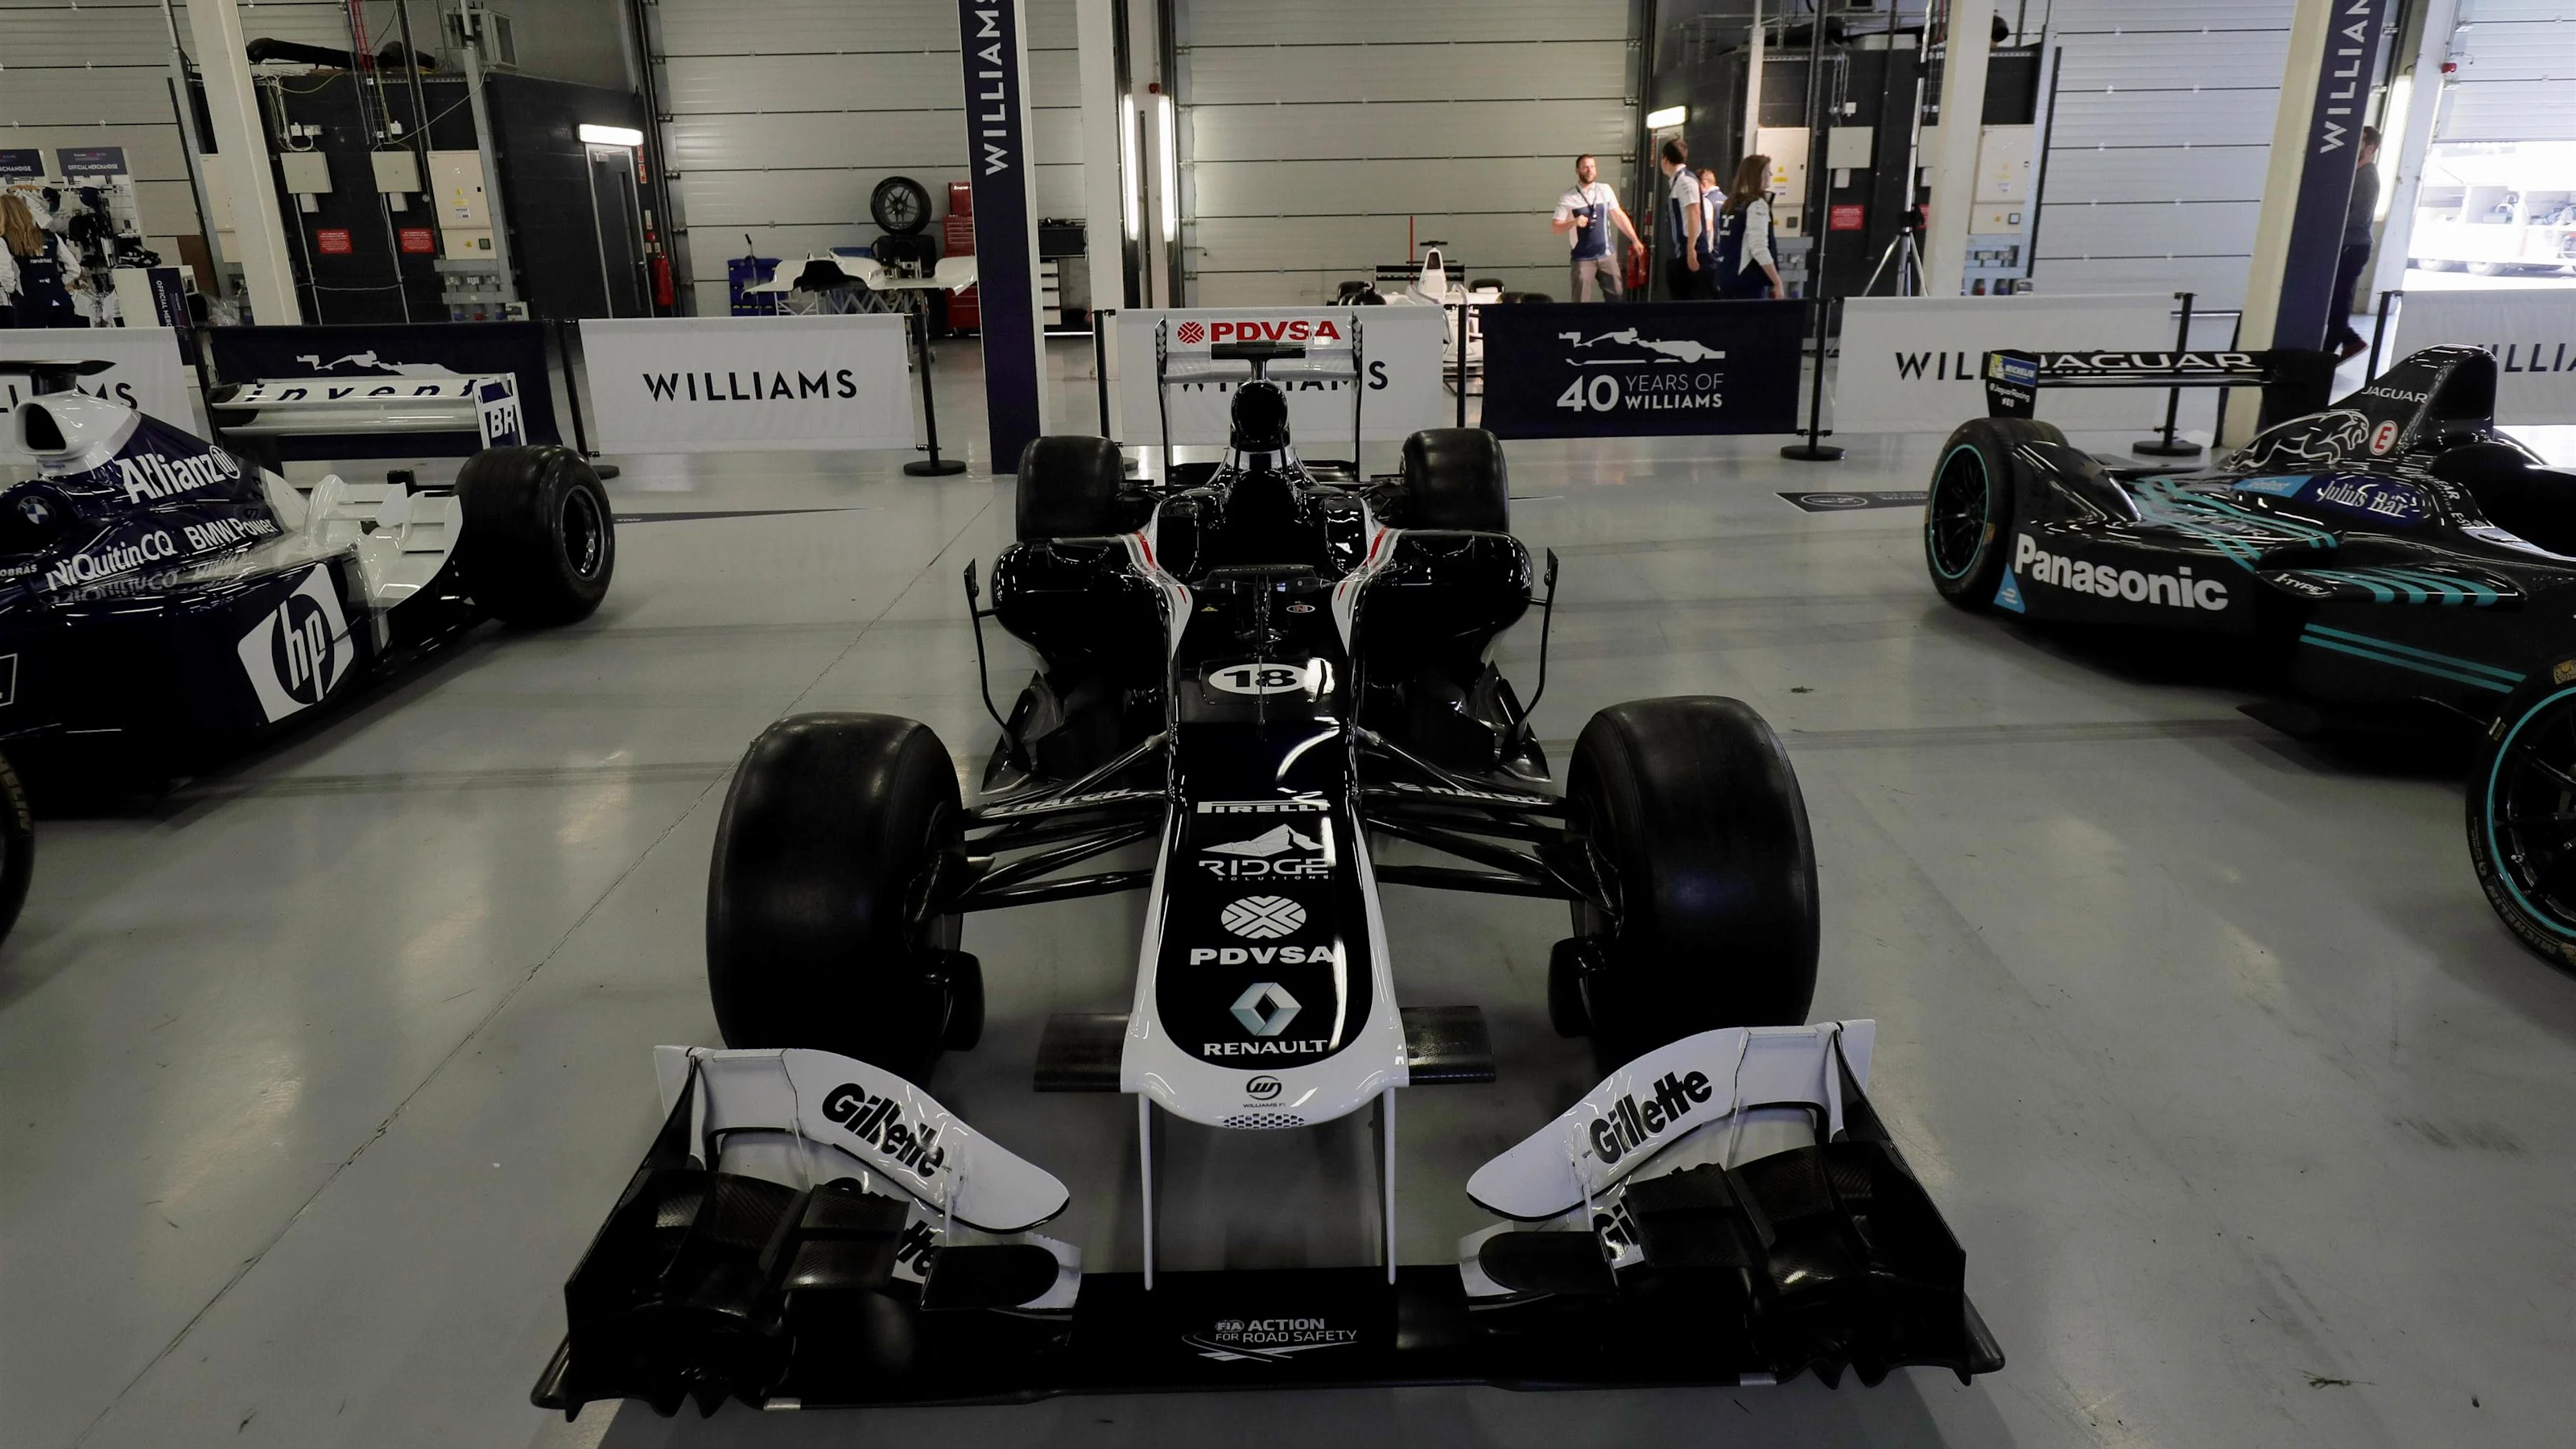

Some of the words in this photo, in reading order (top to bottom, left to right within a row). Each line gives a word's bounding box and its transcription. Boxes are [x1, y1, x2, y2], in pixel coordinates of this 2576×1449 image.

[974, 0, 1009, 175] WILLIAM
[1210, 320, 1341, 342] PDVSA
[2005, 364, 2036, 378] MICHELIN
[642, 369, 857, 402] WILLIAMS
[1557, 374, 1620, 412] 40
[1625, 374, 1689, 392] YEARS
[1695, 373, 1724, 390] OF
[1624, 394, 1723, 410] WILLIAMS
[2360, 386, 2429, 404] JAGUAR
[115, 452, 226, 504] Allianz
[2317, 481, 2368, 509] Julius
[184, 518, 234, 551] BMW
[231, 517, 279, 538] Power
[2014, 532, 2229, 612] Panasonic
[279, 599, 327, 702] hp
[1224, 670, 1297, 687] 18
[1197, 799, 1330, 814] PIRELLI
[1199, 857, 1330, 877] RIDGE
[1217, 874, 1330, 882] SOLUTIONS
[1190, 945, 1333, 966] PDVSA
[1203, 1040, 1327, 1056] RENAULT
[1589, 1071, 1712, 1164] Gillette
[822, 1083, 944, 1178] Gillette
[1217, 1321, 1244, 1331] FIA
[1248, 1318, 1325, 1331] ACTION
[1216, 1333, 1240, 1341] FOR
[1243, 1331, 1289, 1343] ROAD
[1293, 1330, 1357, 1342] SAFETY
